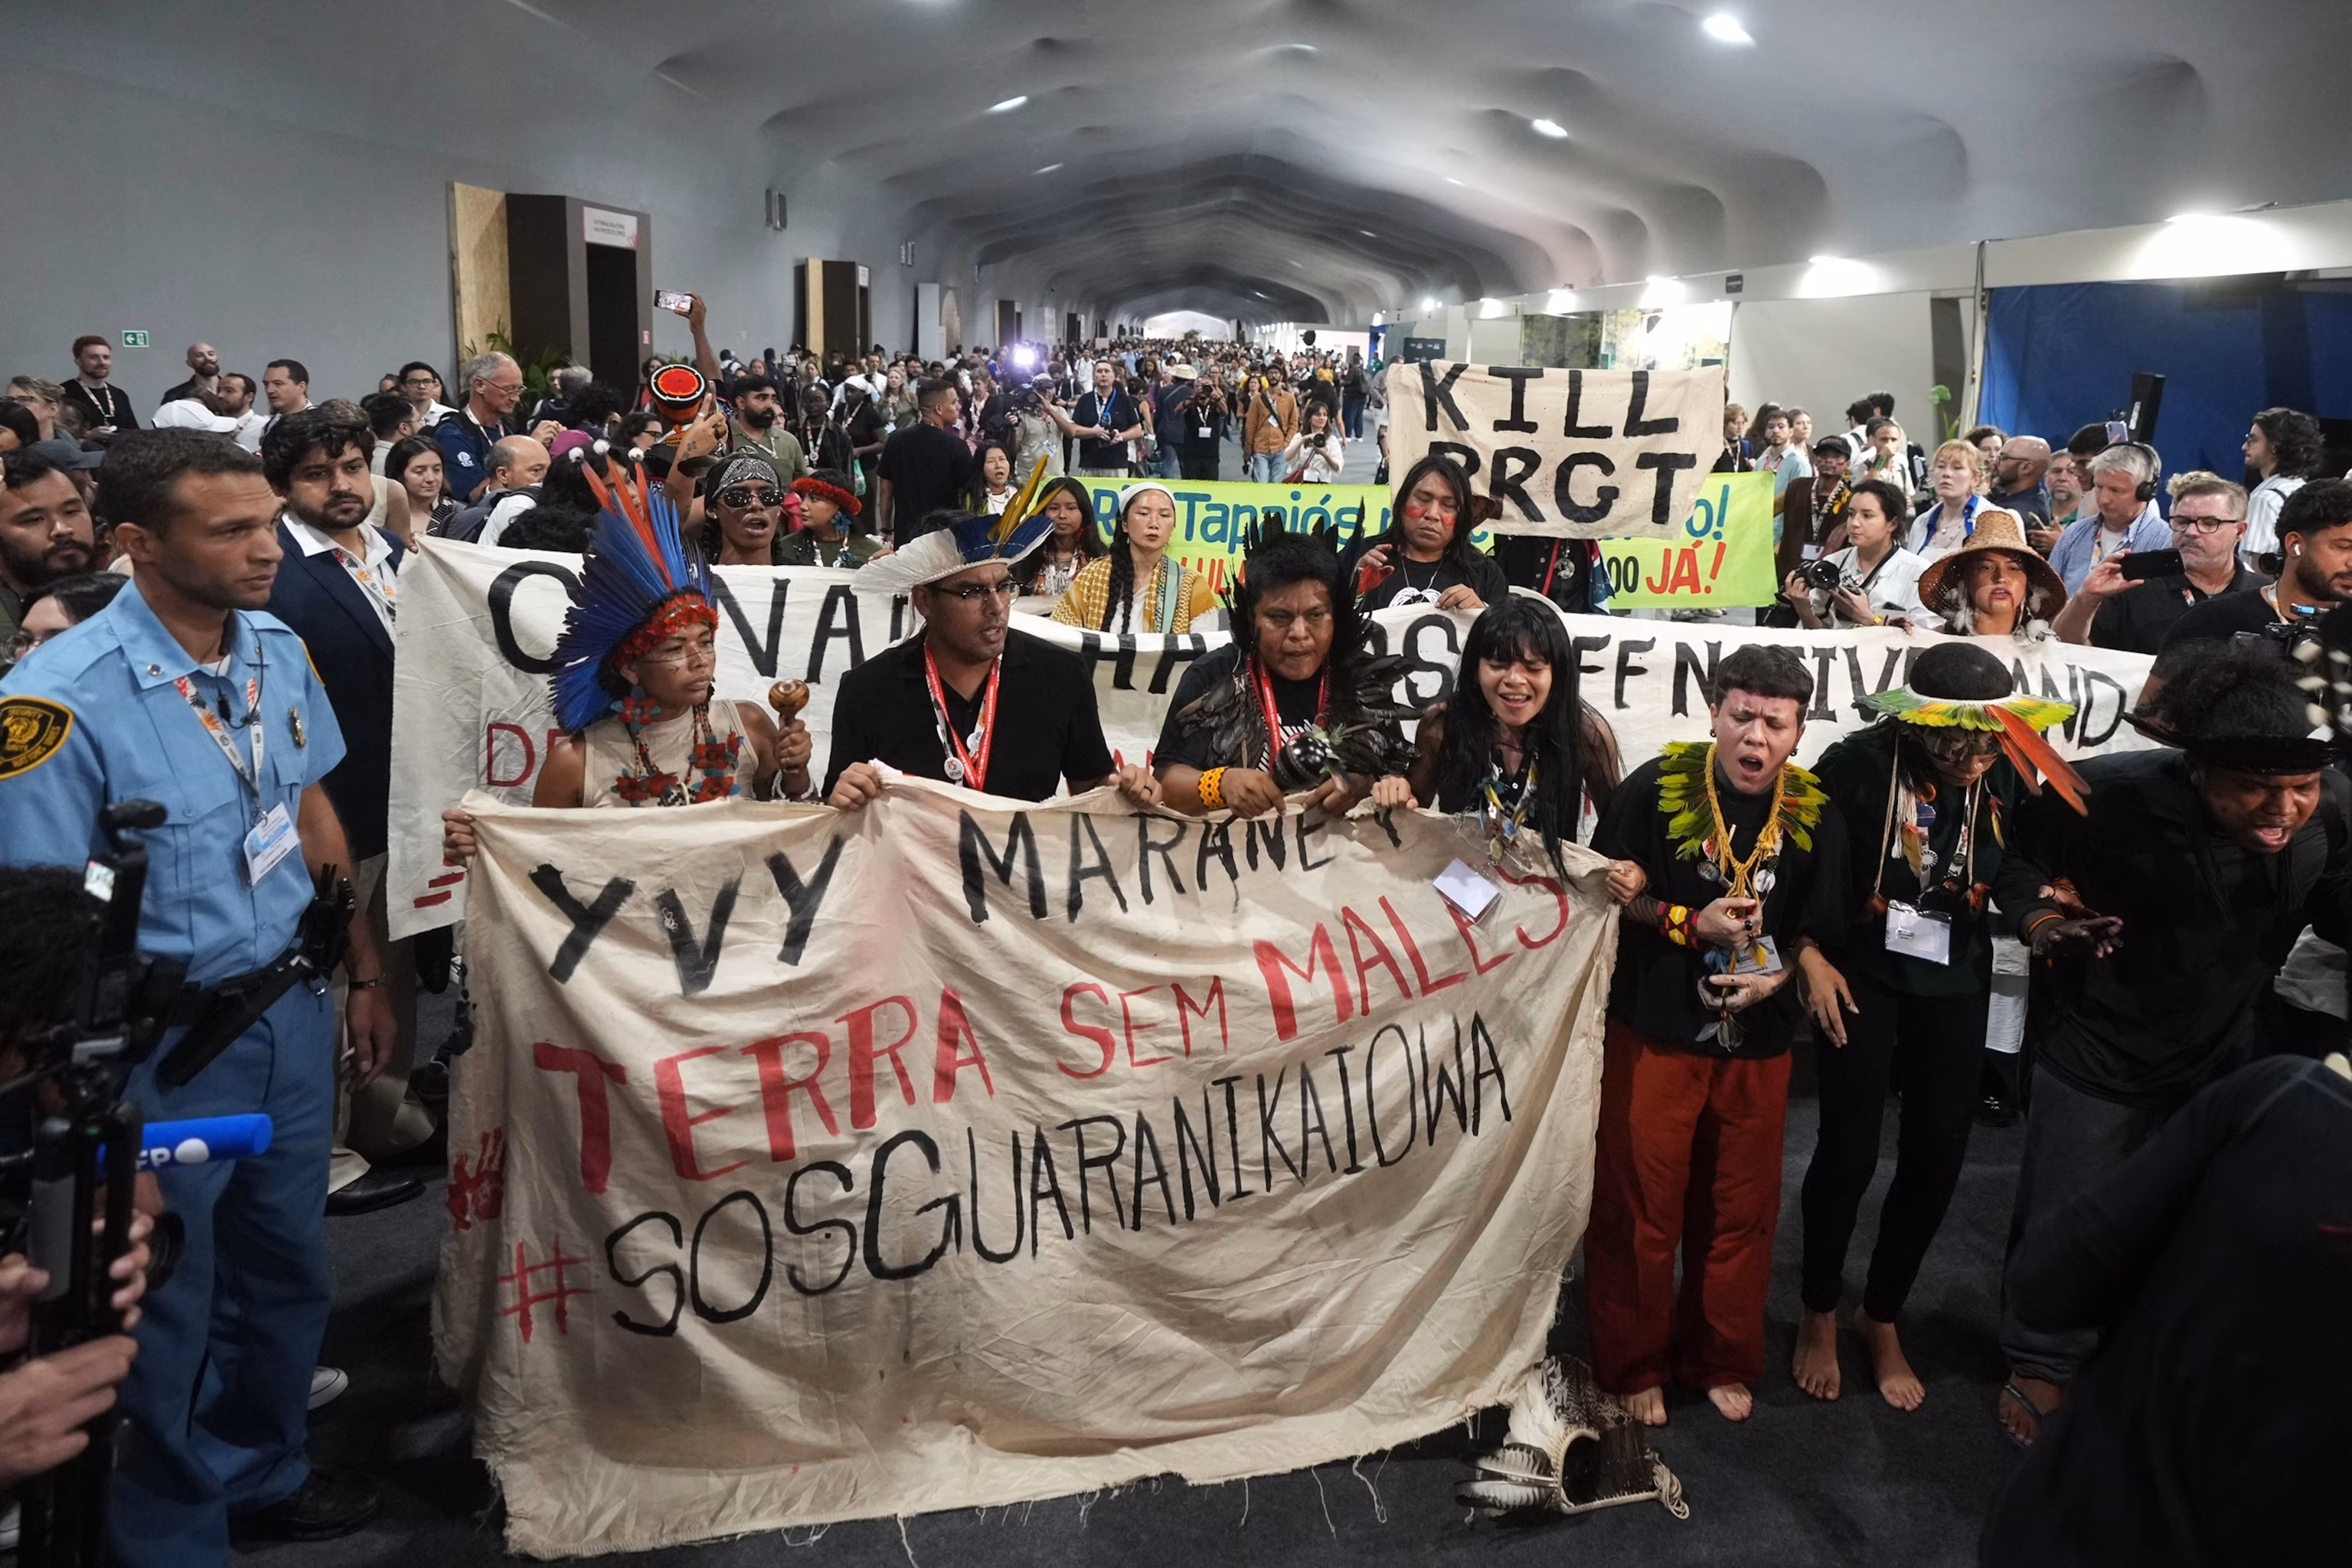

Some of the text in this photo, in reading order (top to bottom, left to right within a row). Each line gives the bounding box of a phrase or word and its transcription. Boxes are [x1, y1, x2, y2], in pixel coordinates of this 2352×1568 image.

[1419, 359, 1679, 439] KILL
[1645, 539, 1726, 596] JÁ!
[528, 833, 843, 996] YVY
[533, 864, 1570, 1196] TERRA SEM MALES
